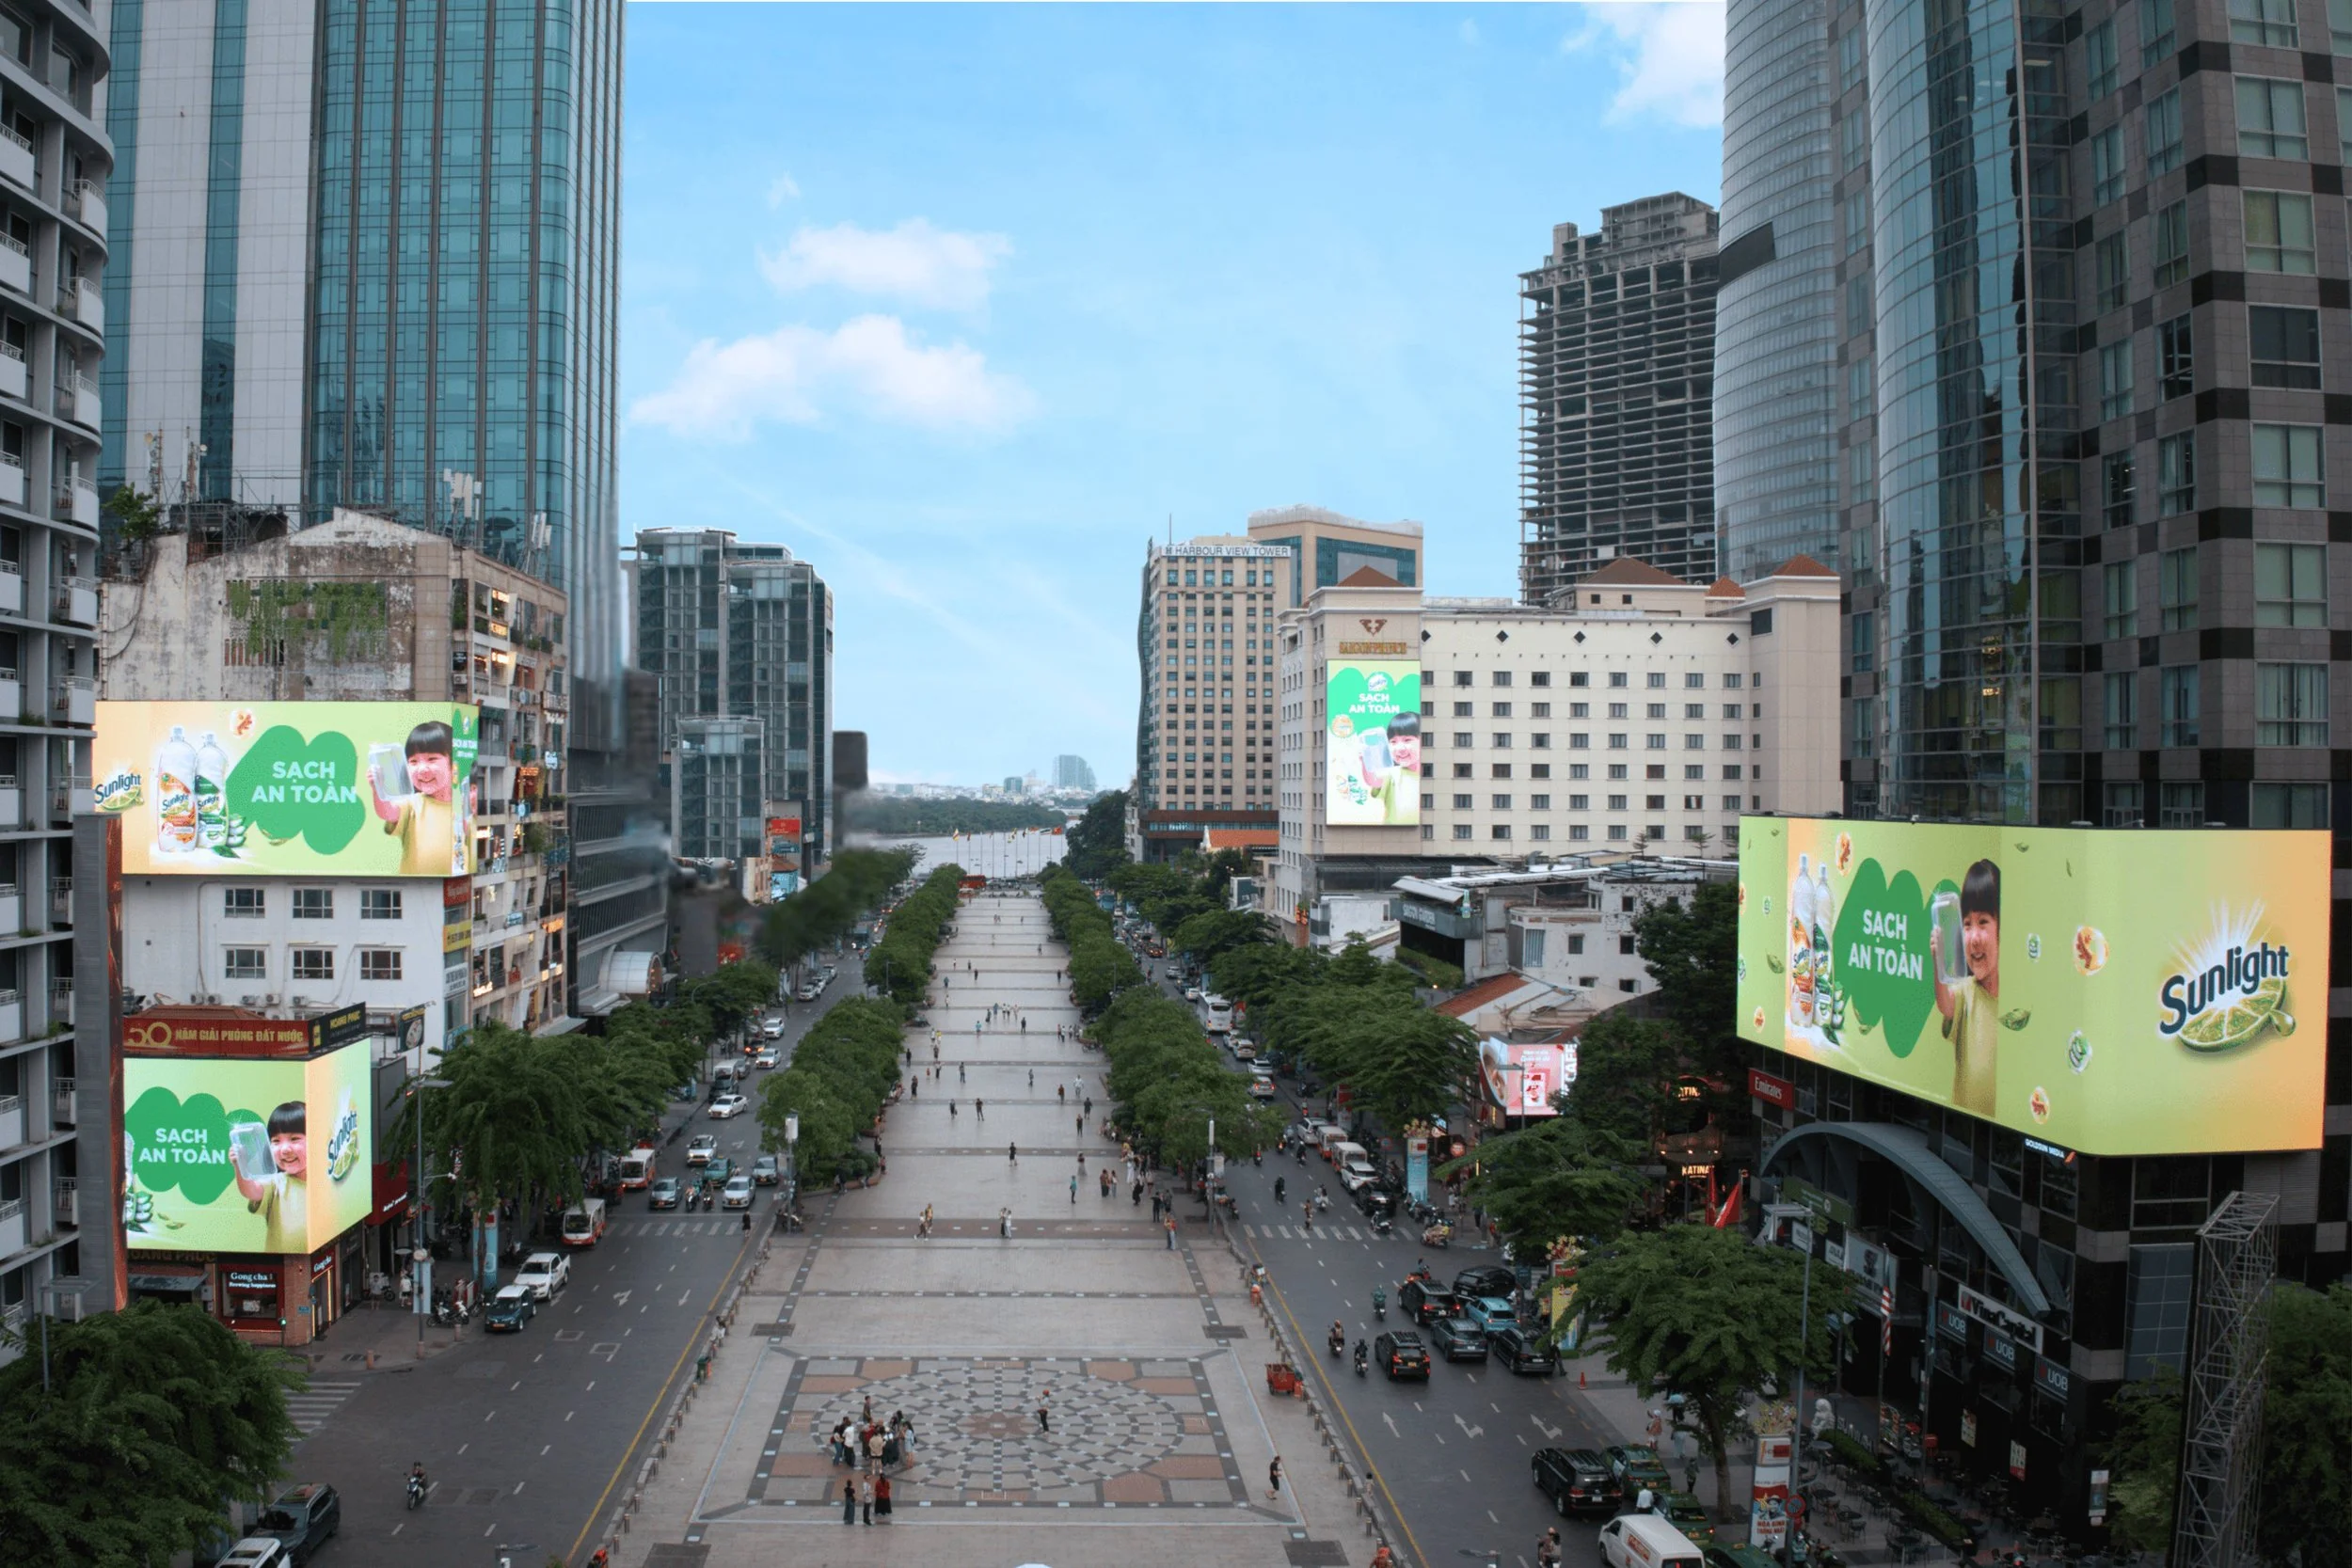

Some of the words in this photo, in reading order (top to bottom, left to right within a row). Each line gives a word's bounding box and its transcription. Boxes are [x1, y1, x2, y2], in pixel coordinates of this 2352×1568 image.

[1176, 546, 1223, 556] HARBOUR
[1225, 546, 1251, 556] VIEW
[1253, 546, 1289, 556] TOWER
[1349, 705, 1365, 714] AN
[1368, 703, 1400, 714] TOÀN
[1359, 693, 1390, 705] SẠCH
[272, 760, 336, 783] SẠCH
[94, 773, 141, 804] Sunlight
[251, 785, 286, 803] AN
[290, 783, 358, 803] TOÀN
[1863, 909, 1908, 942] SẠCH
[1848, 942, 1872, 971] AN
[1874, 943, 1923, 981] TOÀN
[2159, 942, 2290, 1035] Sunlight
[127, 1022, 172, 1046] 50
[175, 1026, 198, 1041] NĂM
[199, 1026, 219, 1041] GIẢI
[221, 1026, 253, 1042] PHÓNG
[256, 1026, 276, 1042] ĐẤT
[278, 1028, 304, 1043] NƯỚC
[1755, 1076, 1782, 1100] Emirates
[155, 1128, 208, 1148] SẠCH
[327, 1109, 358, 1176] Sunlight
[138, 1148, 167, 1164] AN
[171, 1147, 226, 1165] TOÀN
[230, 1272, 252, 1283] Gong
[1948, 1313, 1966, 1334] UOB
[1971, 1296, 2037, 1348] VinaCapital
[1995, 1338, 2015, 1361] UOB
[2047, 1369, 2068, 1391] UOB
